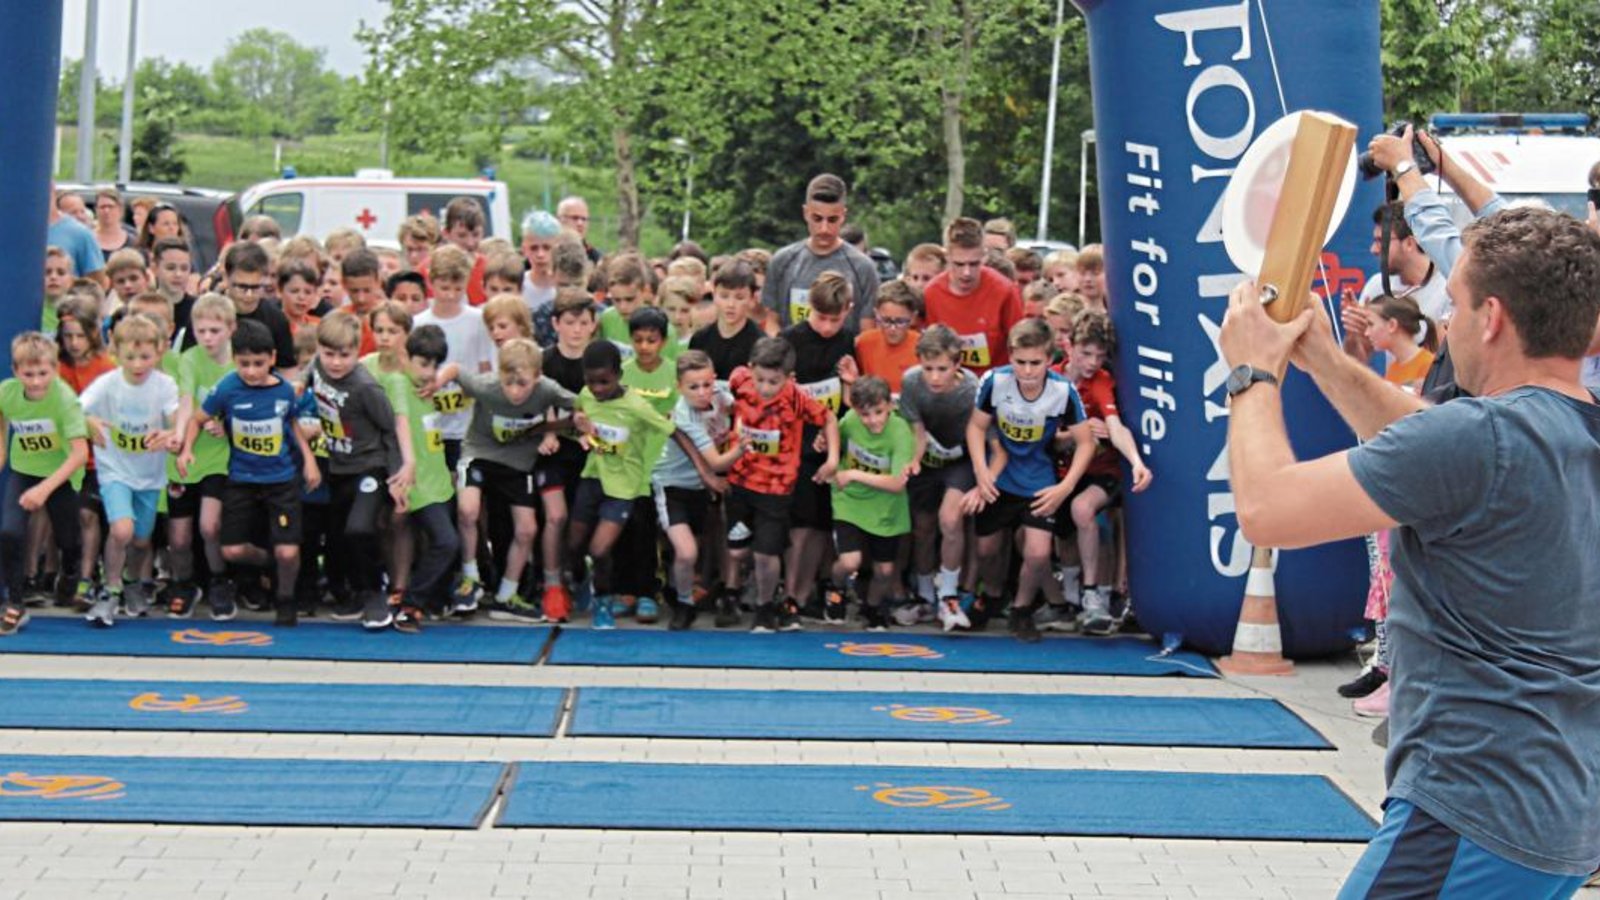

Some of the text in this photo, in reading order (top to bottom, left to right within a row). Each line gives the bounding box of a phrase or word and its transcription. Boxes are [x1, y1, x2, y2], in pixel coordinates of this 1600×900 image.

[1125, 140, 1176, 455] Fit for life.
[433, 393, 464, 411] 512
[242, 422, 273, 435] alwa
[1002, 421, 1034, 441] 633
[19, 435, 52, 452] 150
[240, 436, 274, 453] 465
